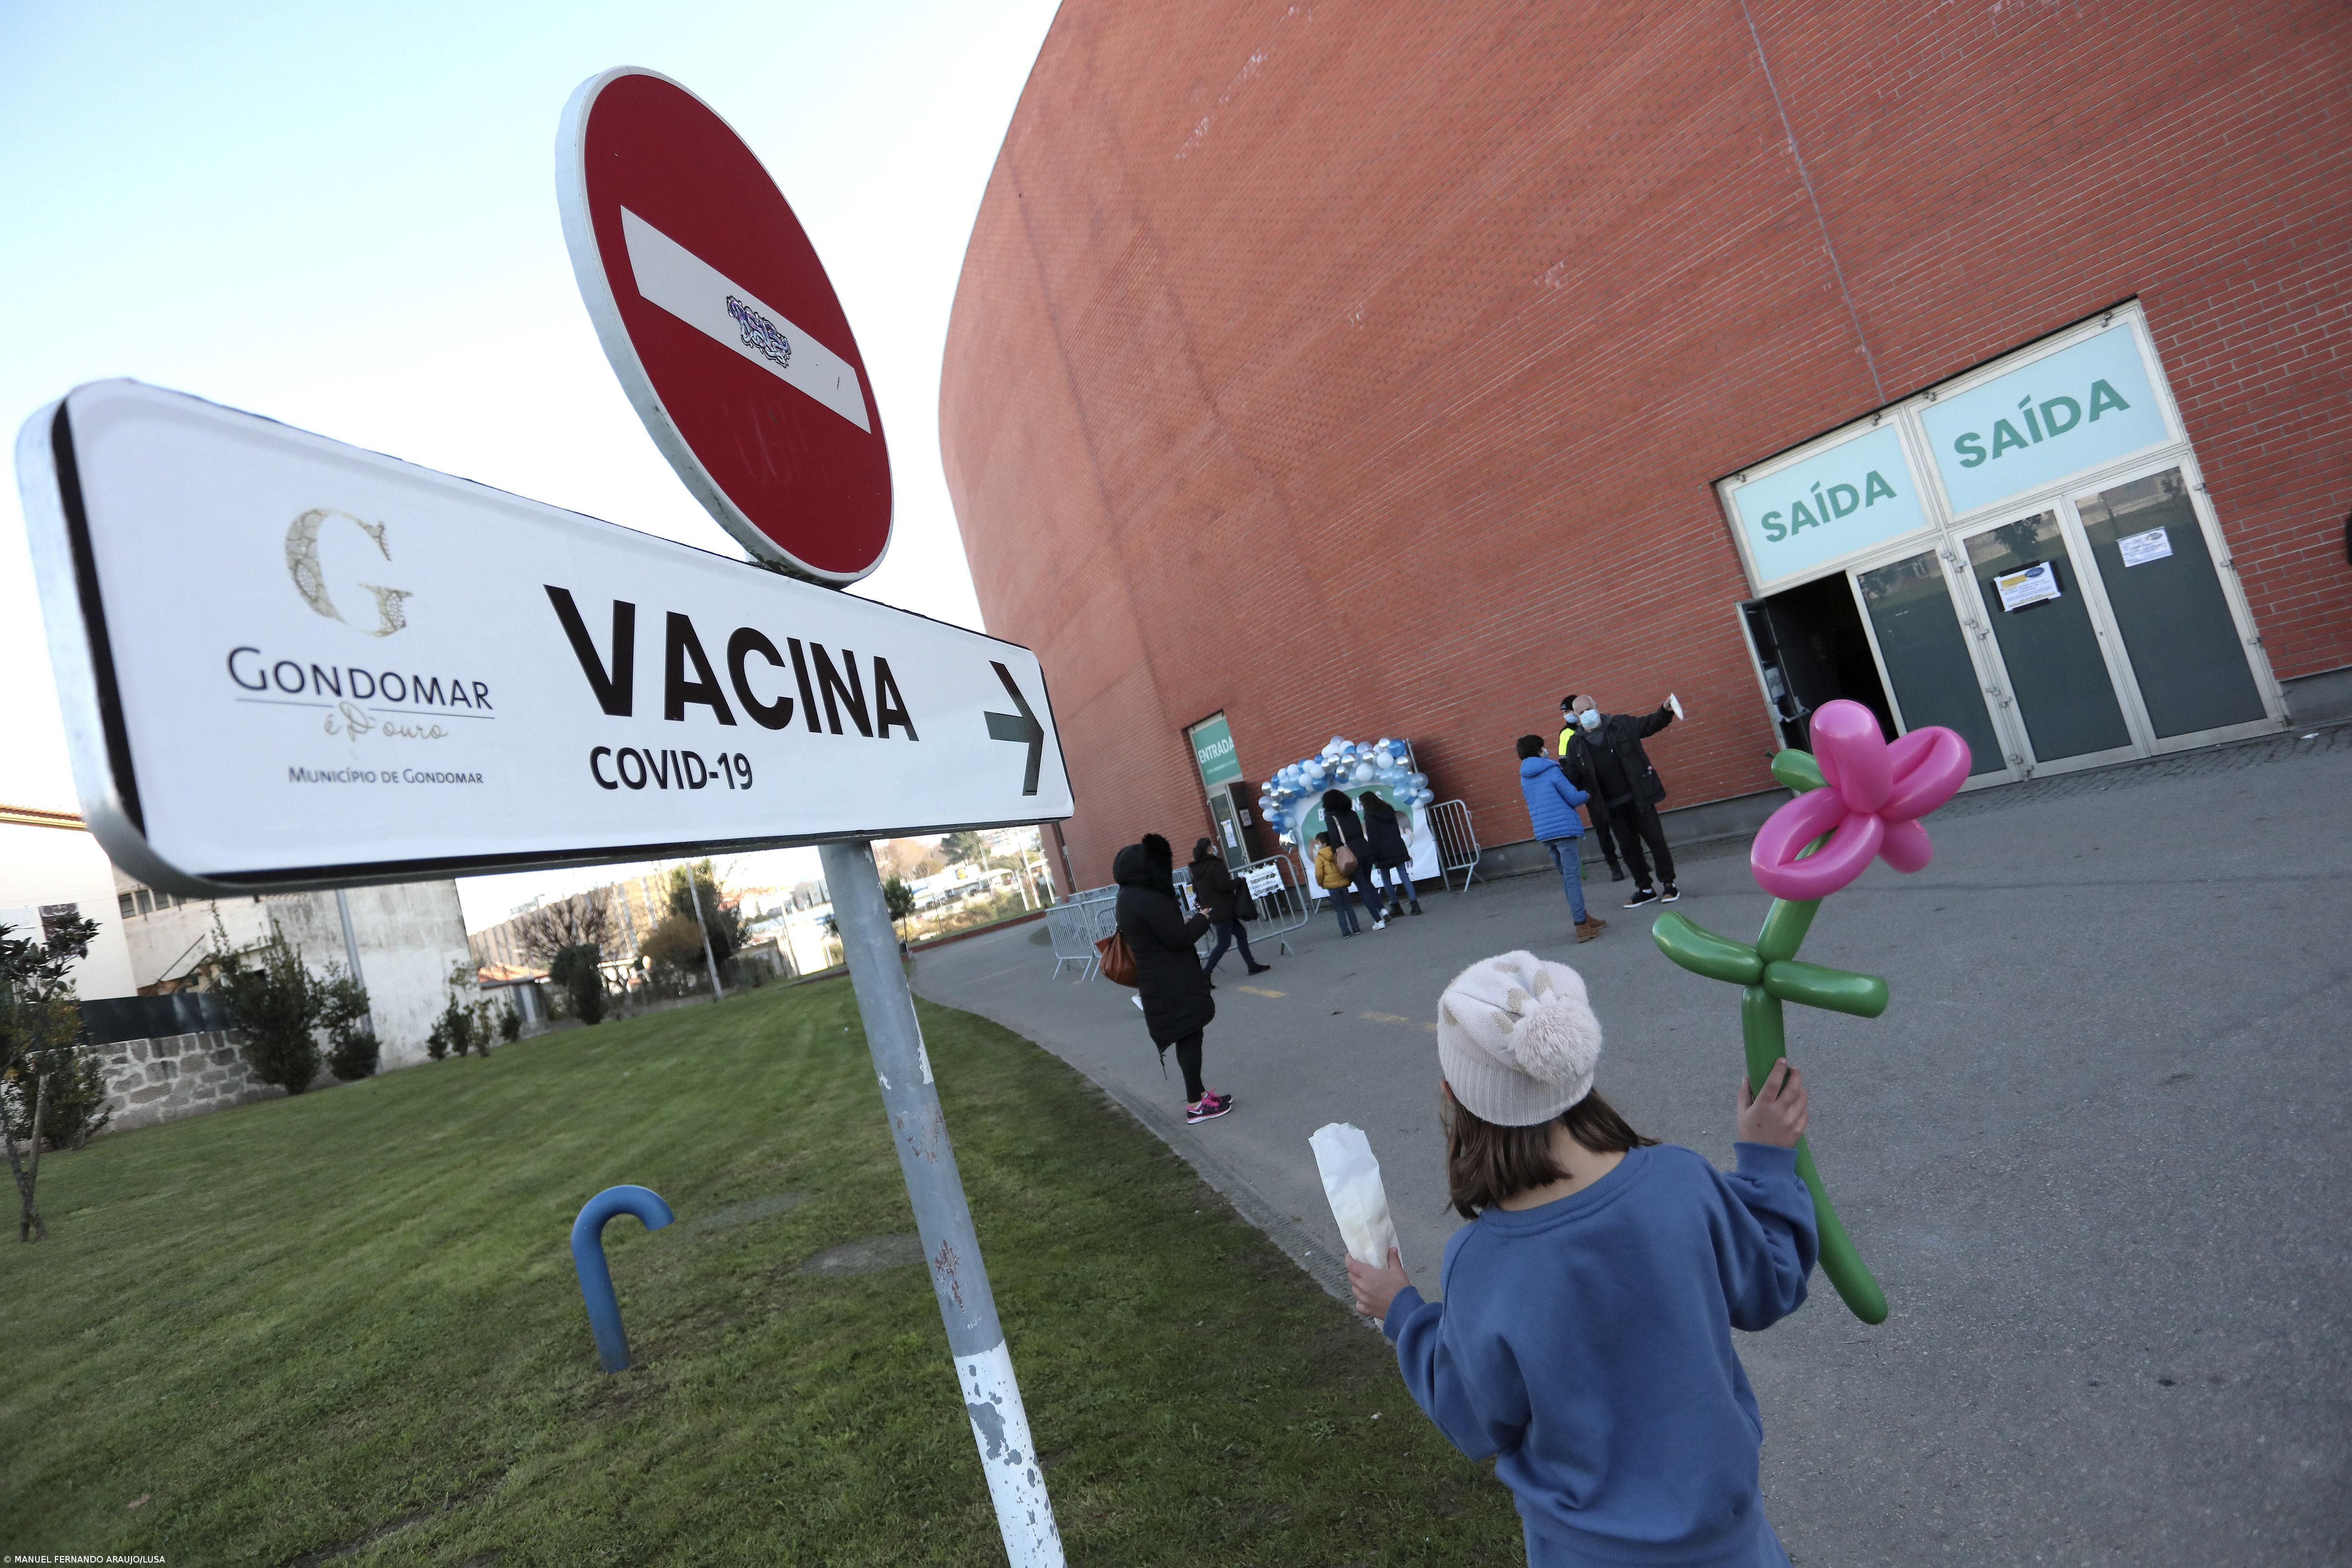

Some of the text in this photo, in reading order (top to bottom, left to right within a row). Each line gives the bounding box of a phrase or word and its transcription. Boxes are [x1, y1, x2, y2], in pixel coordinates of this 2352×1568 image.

[1954, 379, 2131, 468] SAÍDA
[1761, 470, 1896, 542] SAÍDA
[226, 646, 493, 710] GONDOMAR
[543, 584, 919, 742] VACINA
[288, 767, 484, 784] MUNICÍPIO DE GONDOMAR
[590, 746, 753, 790] COVID-19
[1198, 736, 1234, 764] ENTRADA
